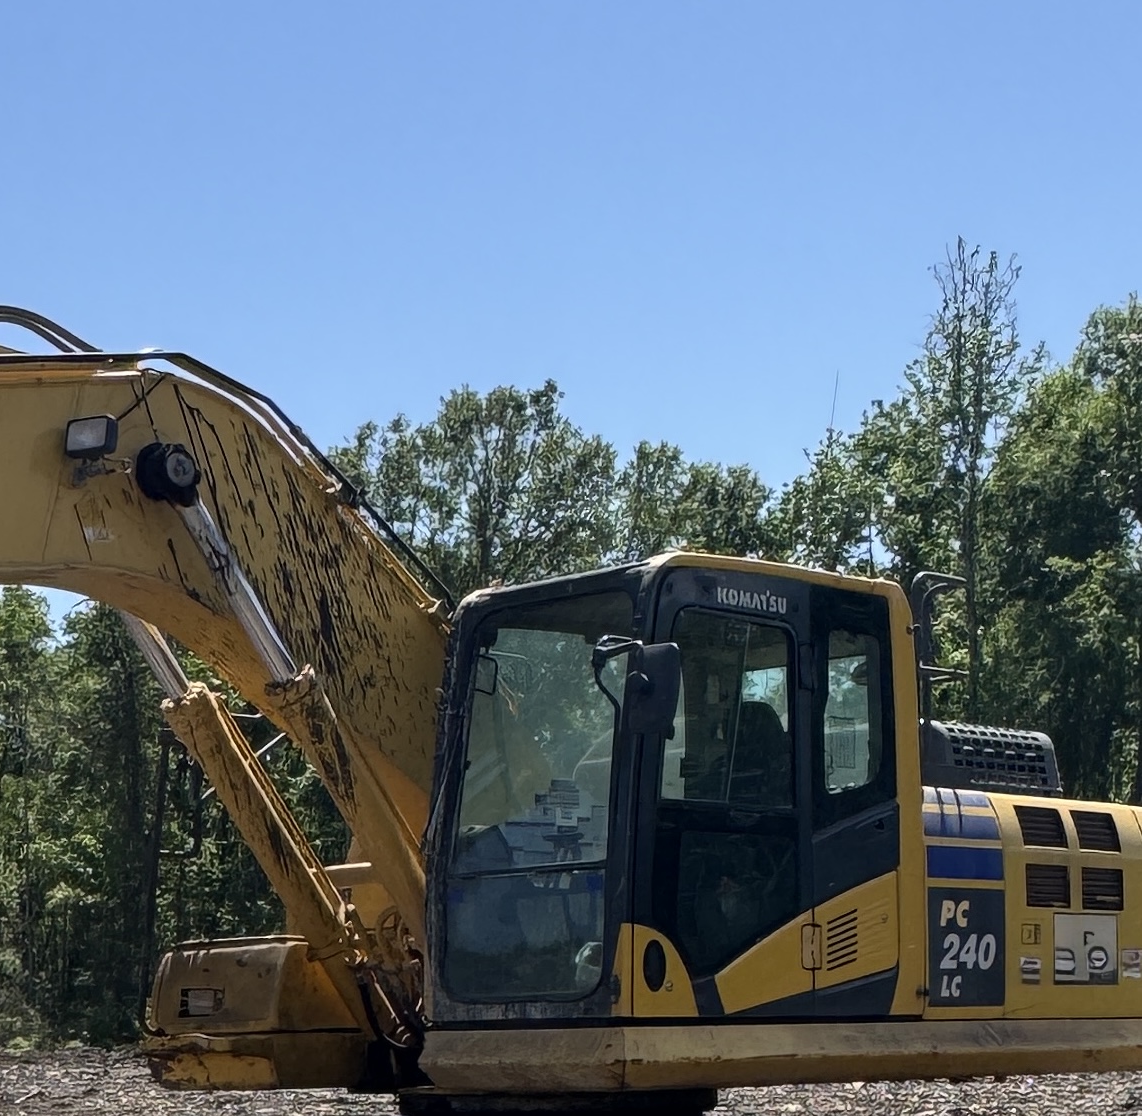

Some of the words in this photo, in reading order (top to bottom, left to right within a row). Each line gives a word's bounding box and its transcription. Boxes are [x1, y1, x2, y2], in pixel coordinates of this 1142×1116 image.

[717, 586, 787, 614] KOMATSU
[940, 900, 970, 927] PC
[939, 933, 996, 970] 240
[940, 975, 962, 997] LC
